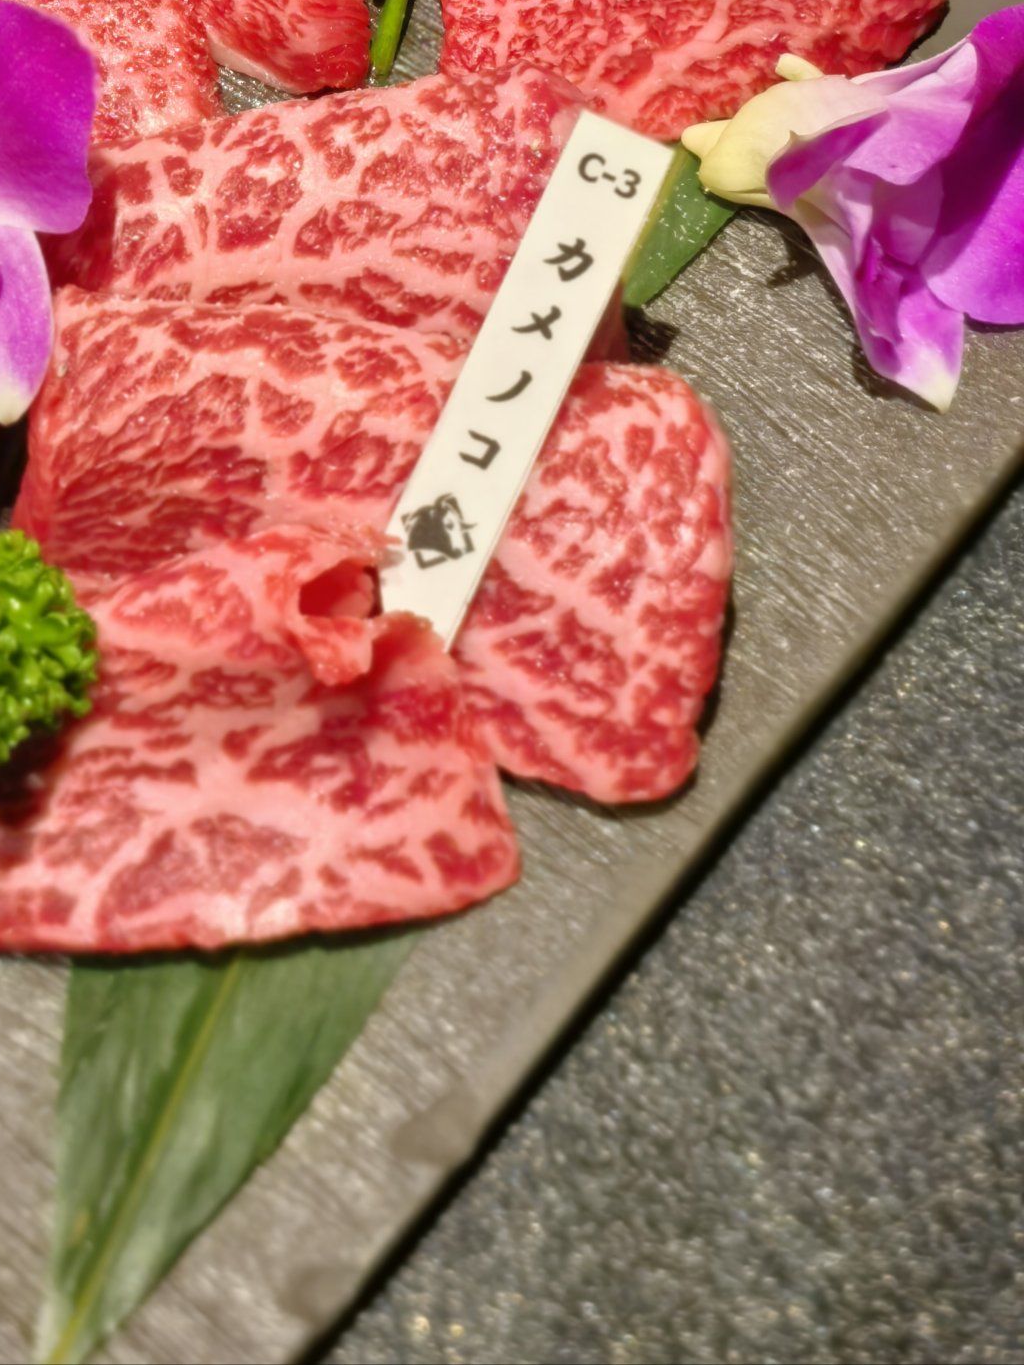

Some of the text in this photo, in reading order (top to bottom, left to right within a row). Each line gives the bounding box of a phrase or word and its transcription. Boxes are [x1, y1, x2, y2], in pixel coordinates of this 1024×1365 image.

[578, 152, 642, 200] C-3
[459, 237, 594, 471] カメノコ
